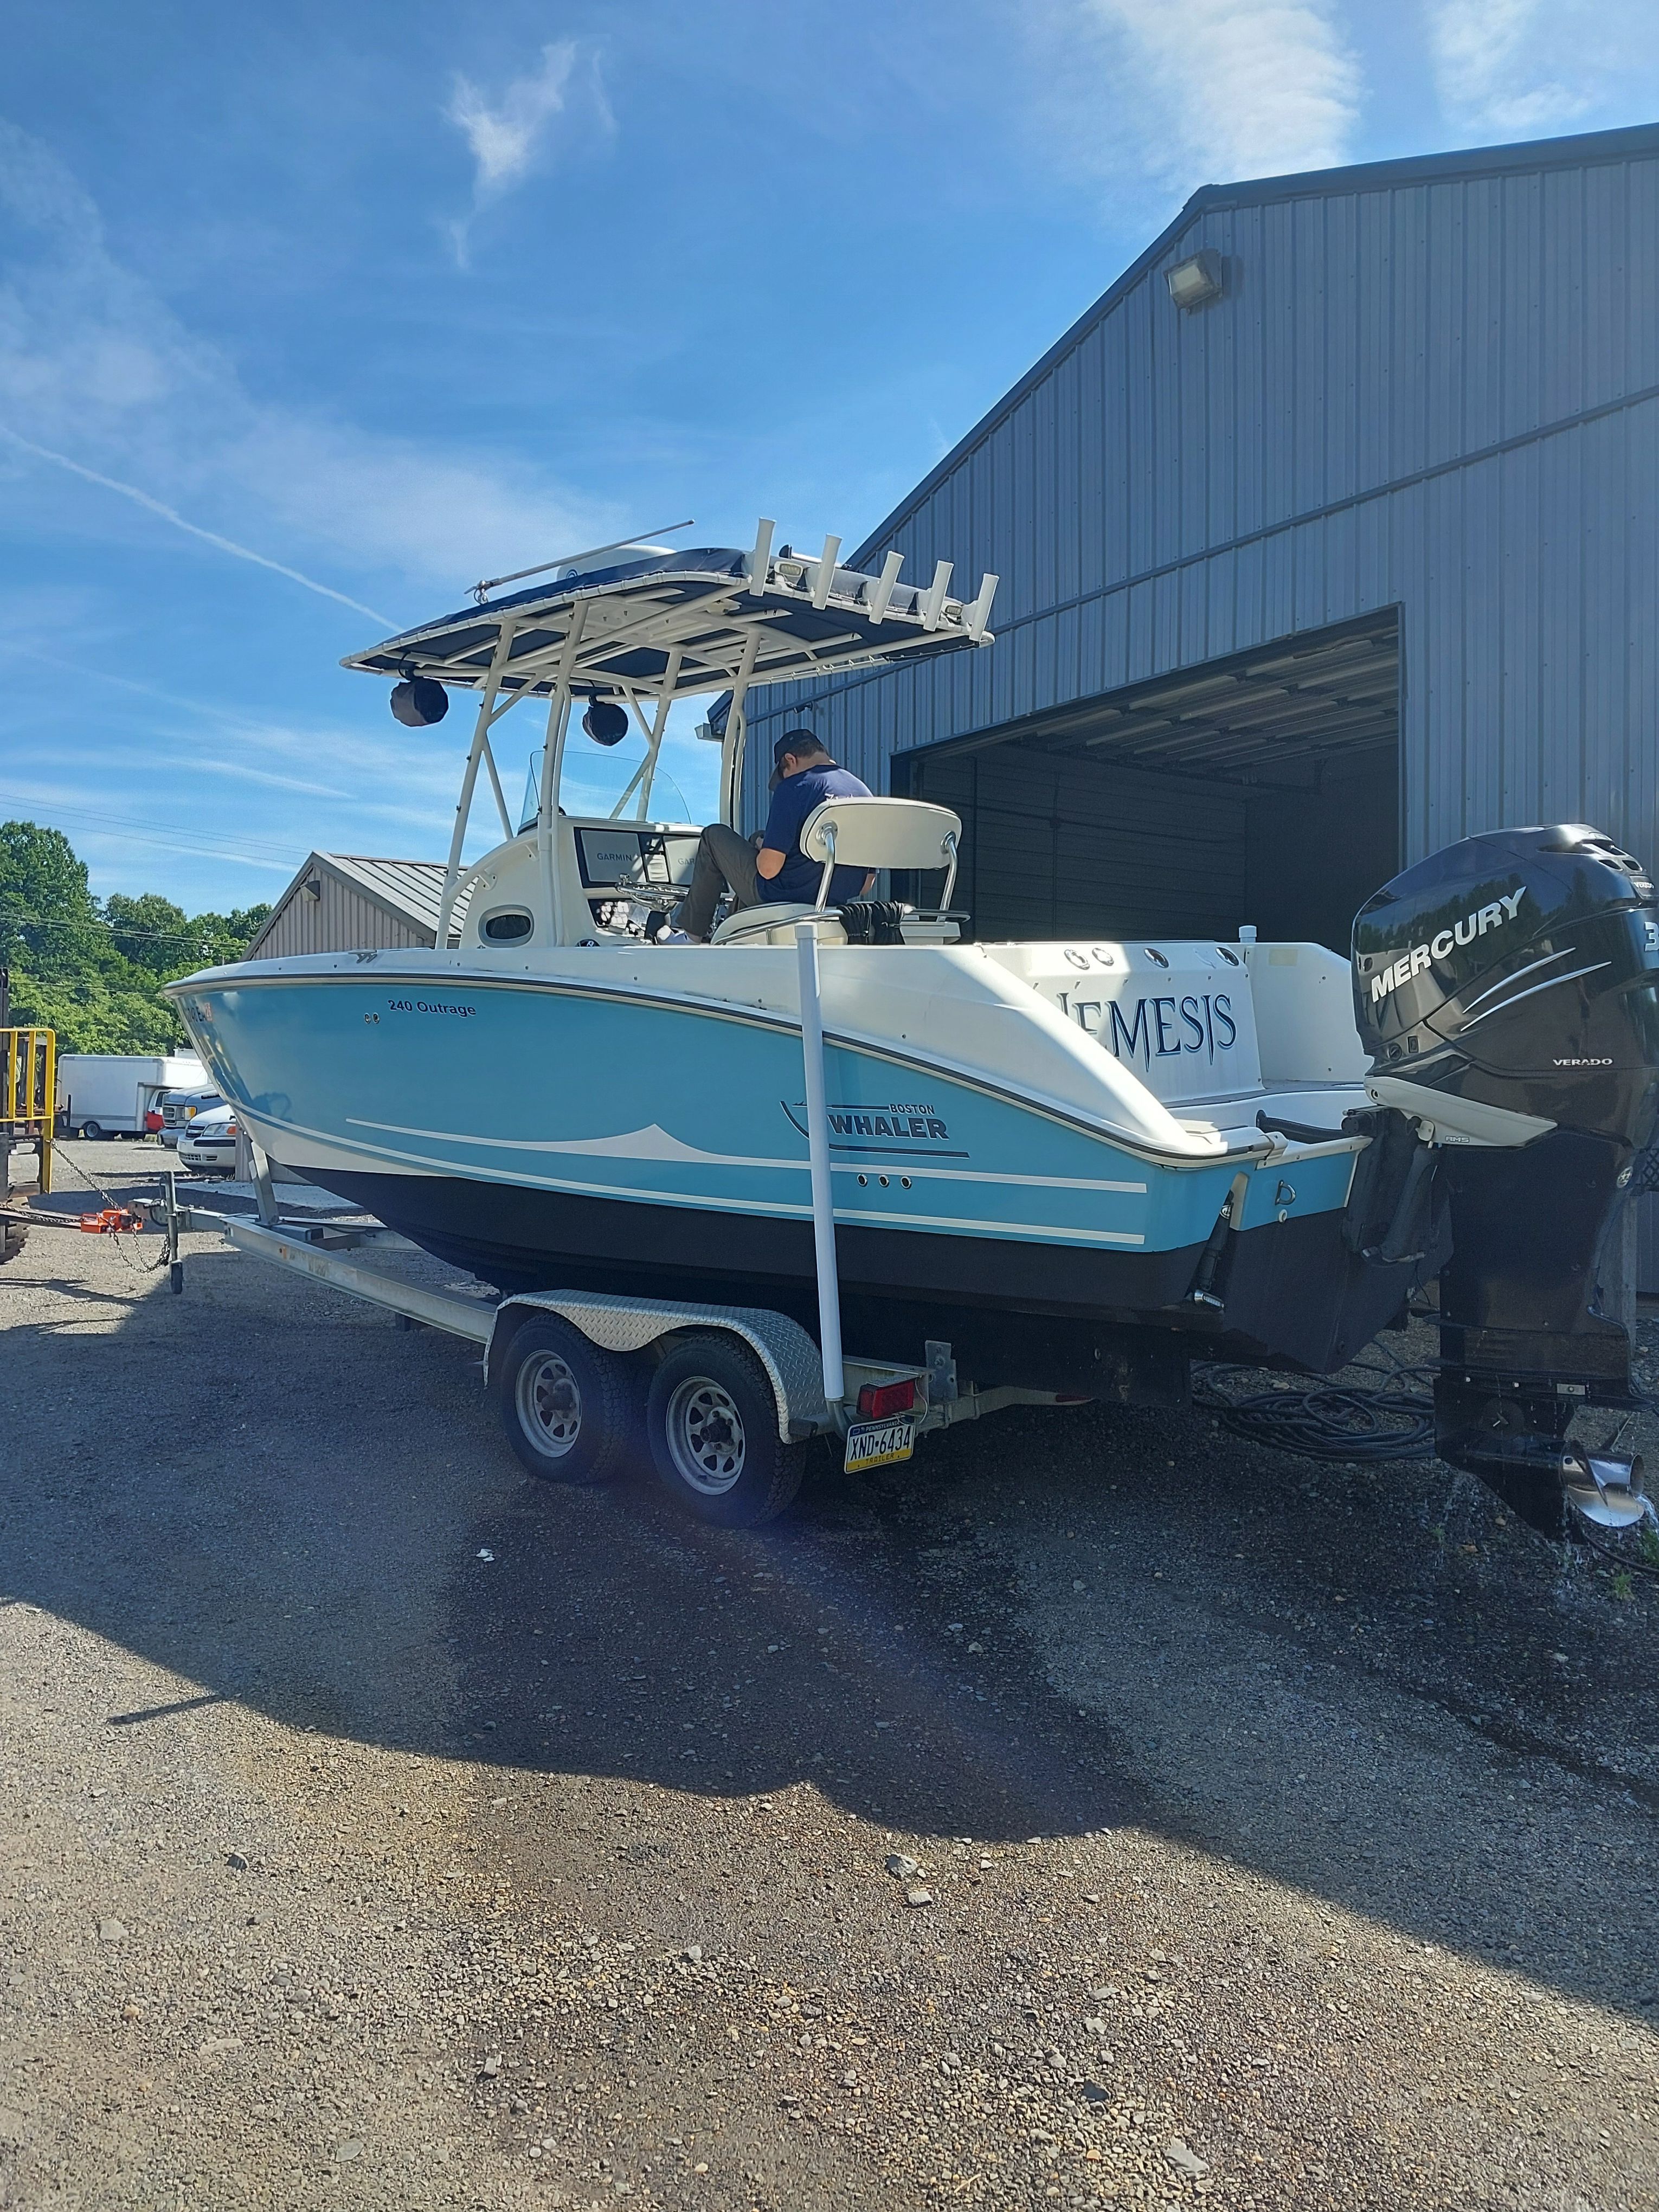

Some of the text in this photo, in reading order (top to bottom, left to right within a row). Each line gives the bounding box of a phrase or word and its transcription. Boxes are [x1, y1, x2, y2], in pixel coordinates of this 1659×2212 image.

[597, 853, 632, 861] GARMIN
[1371, 886, 1527, 1003] MERCURY
[388, 1000, 476, 1018] 240 Outrage
[889, 1104, 935, 1115] BOSTON
[827, 1114, 950, 1140] WHALER
[866, 1420, 900, 1431] PENNSYLVANIA
[866, 1453, 894, 1464] TRAILER
